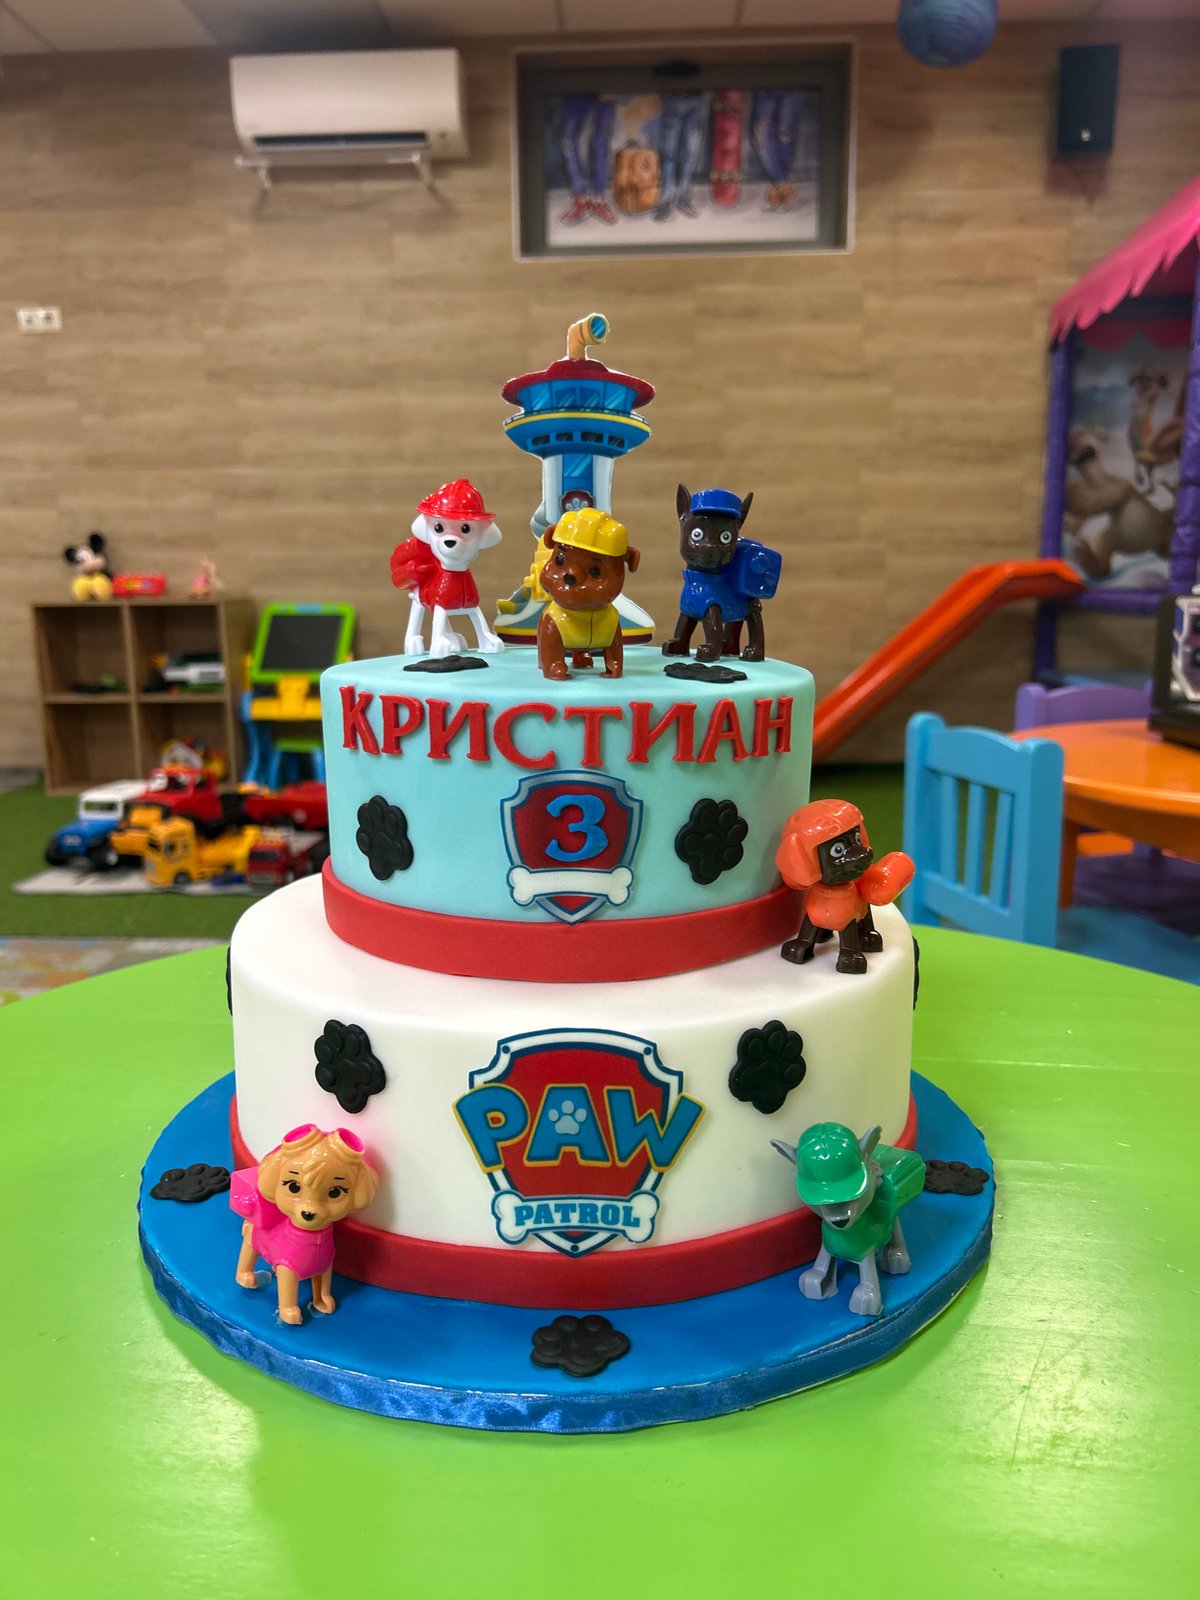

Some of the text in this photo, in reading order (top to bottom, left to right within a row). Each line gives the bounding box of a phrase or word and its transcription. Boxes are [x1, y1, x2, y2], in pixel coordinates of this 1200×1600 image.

[339, 685, 794, 769] КРИСТИАН
[545, 794, 609, 862] 3
[452, 1083, 705, 1174] PAW
[513, 1202, 641, 1228] PATROL
